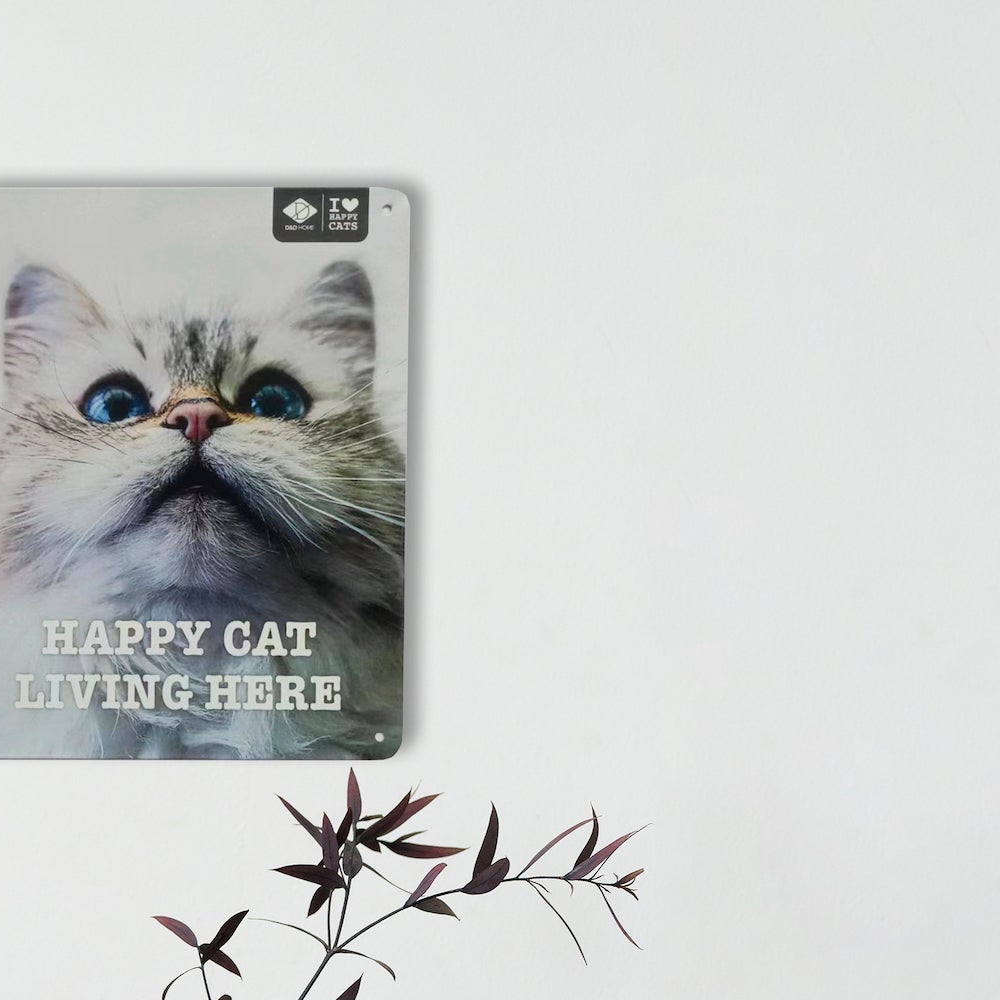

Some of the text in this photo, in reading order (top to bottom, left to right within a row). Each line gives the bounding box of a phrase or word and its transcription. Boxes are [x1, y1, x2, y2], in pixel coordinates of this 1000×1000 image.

[329, 198, 340, 212] I
[328, 221, 358, 230] CATS
[42, 620, 317, 657] HAPPY CAT
[14, 673, 341, 711] LIVING HERE
